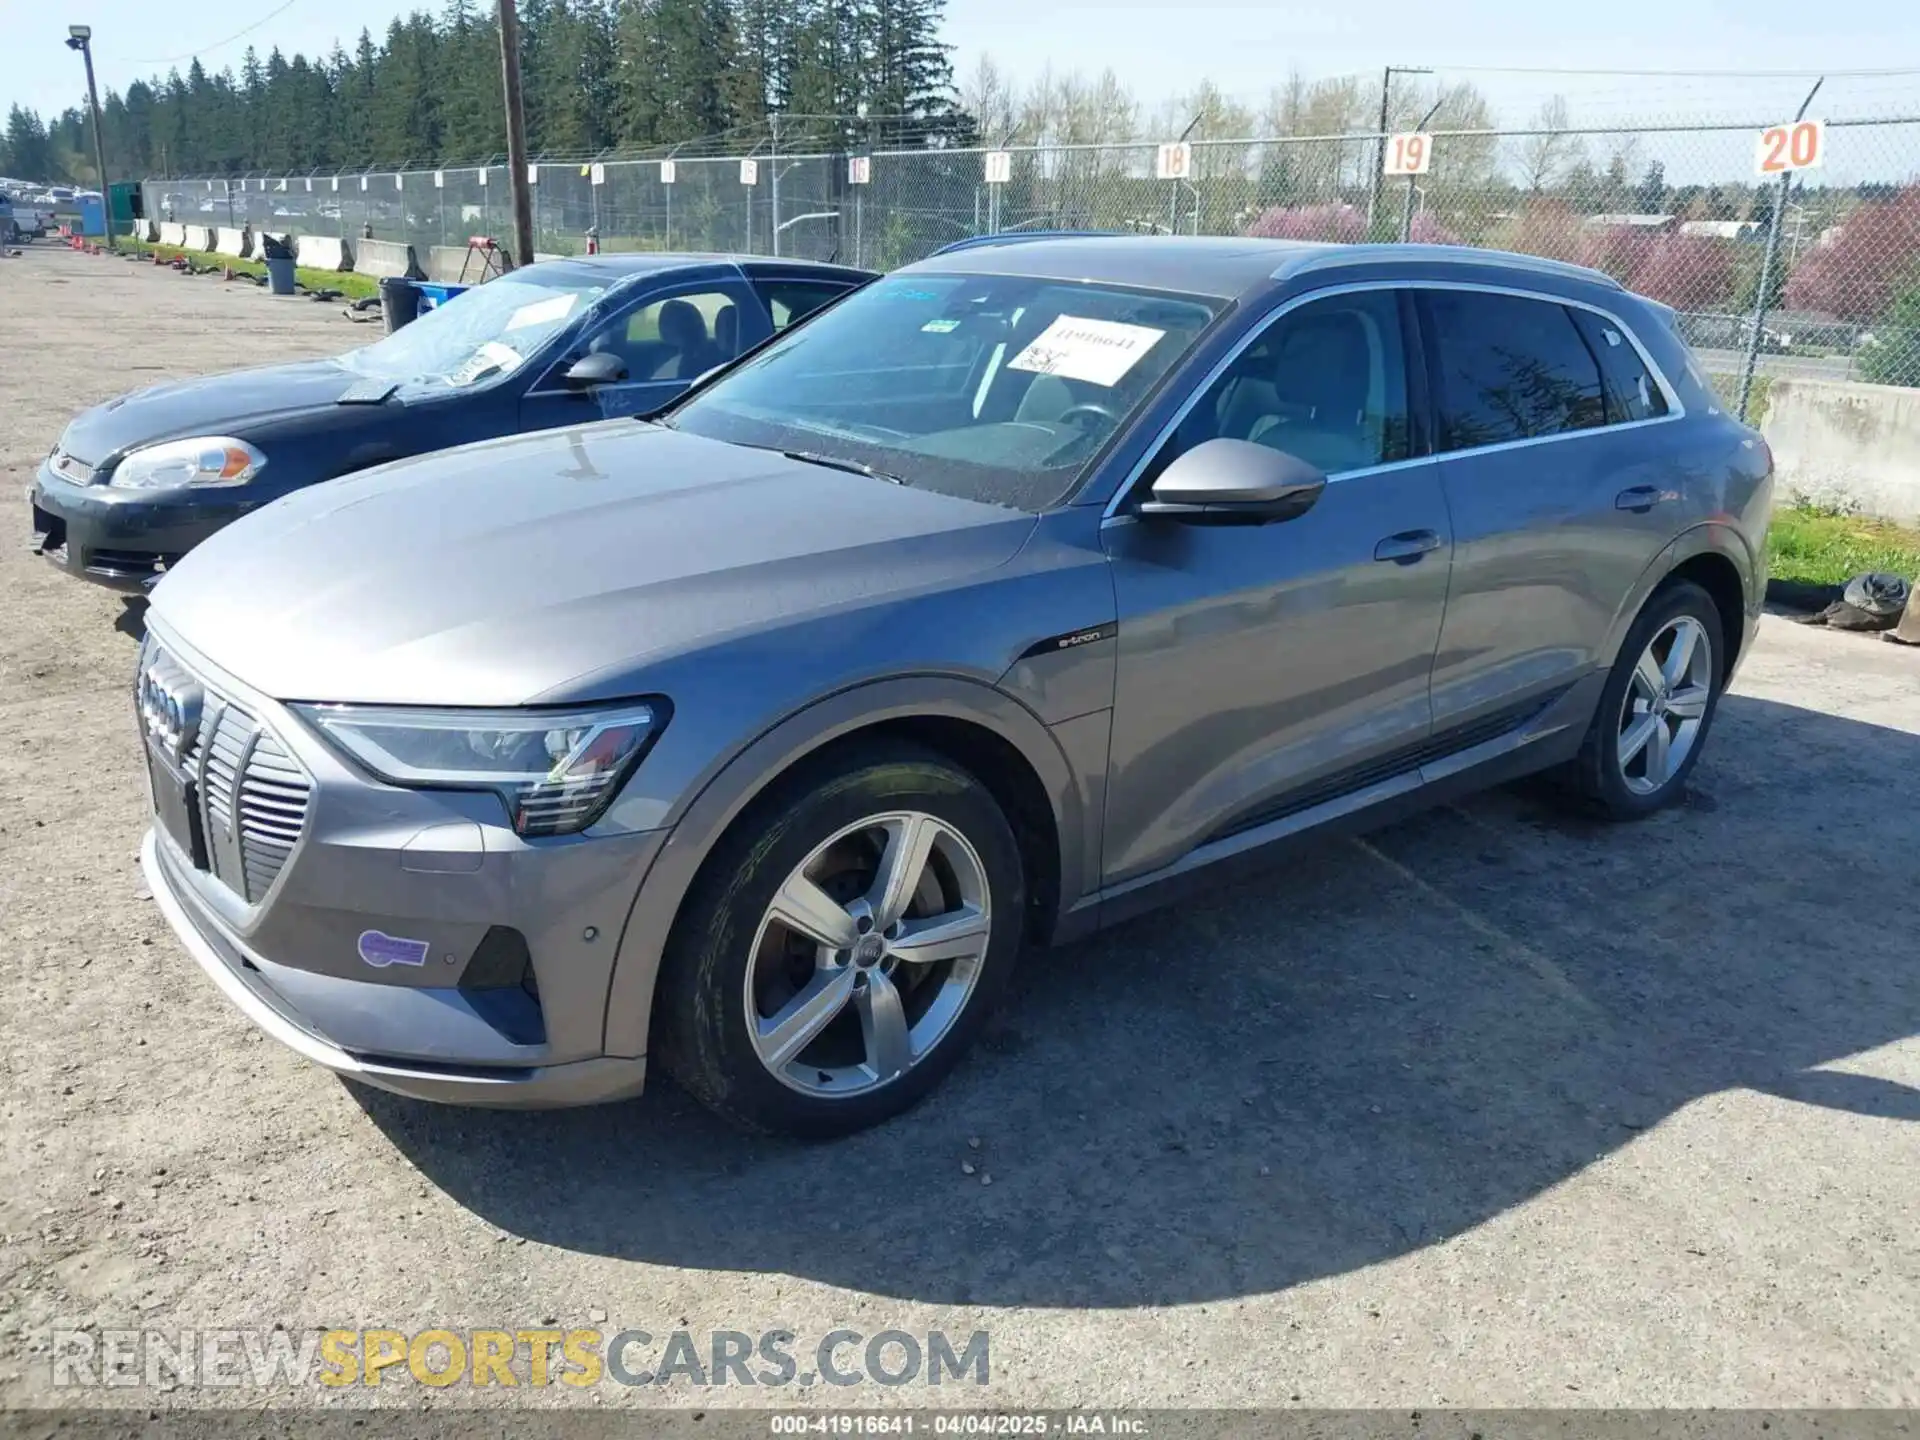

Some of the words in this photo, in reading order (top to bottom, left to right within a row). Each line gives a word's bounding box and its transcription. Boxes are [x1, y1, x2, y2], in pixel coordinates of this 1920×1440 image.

[1164, 146, 1184, 175] 18
[1394, 136, 1423, 171] 19
[1761, 122, 1817, 171] 20
